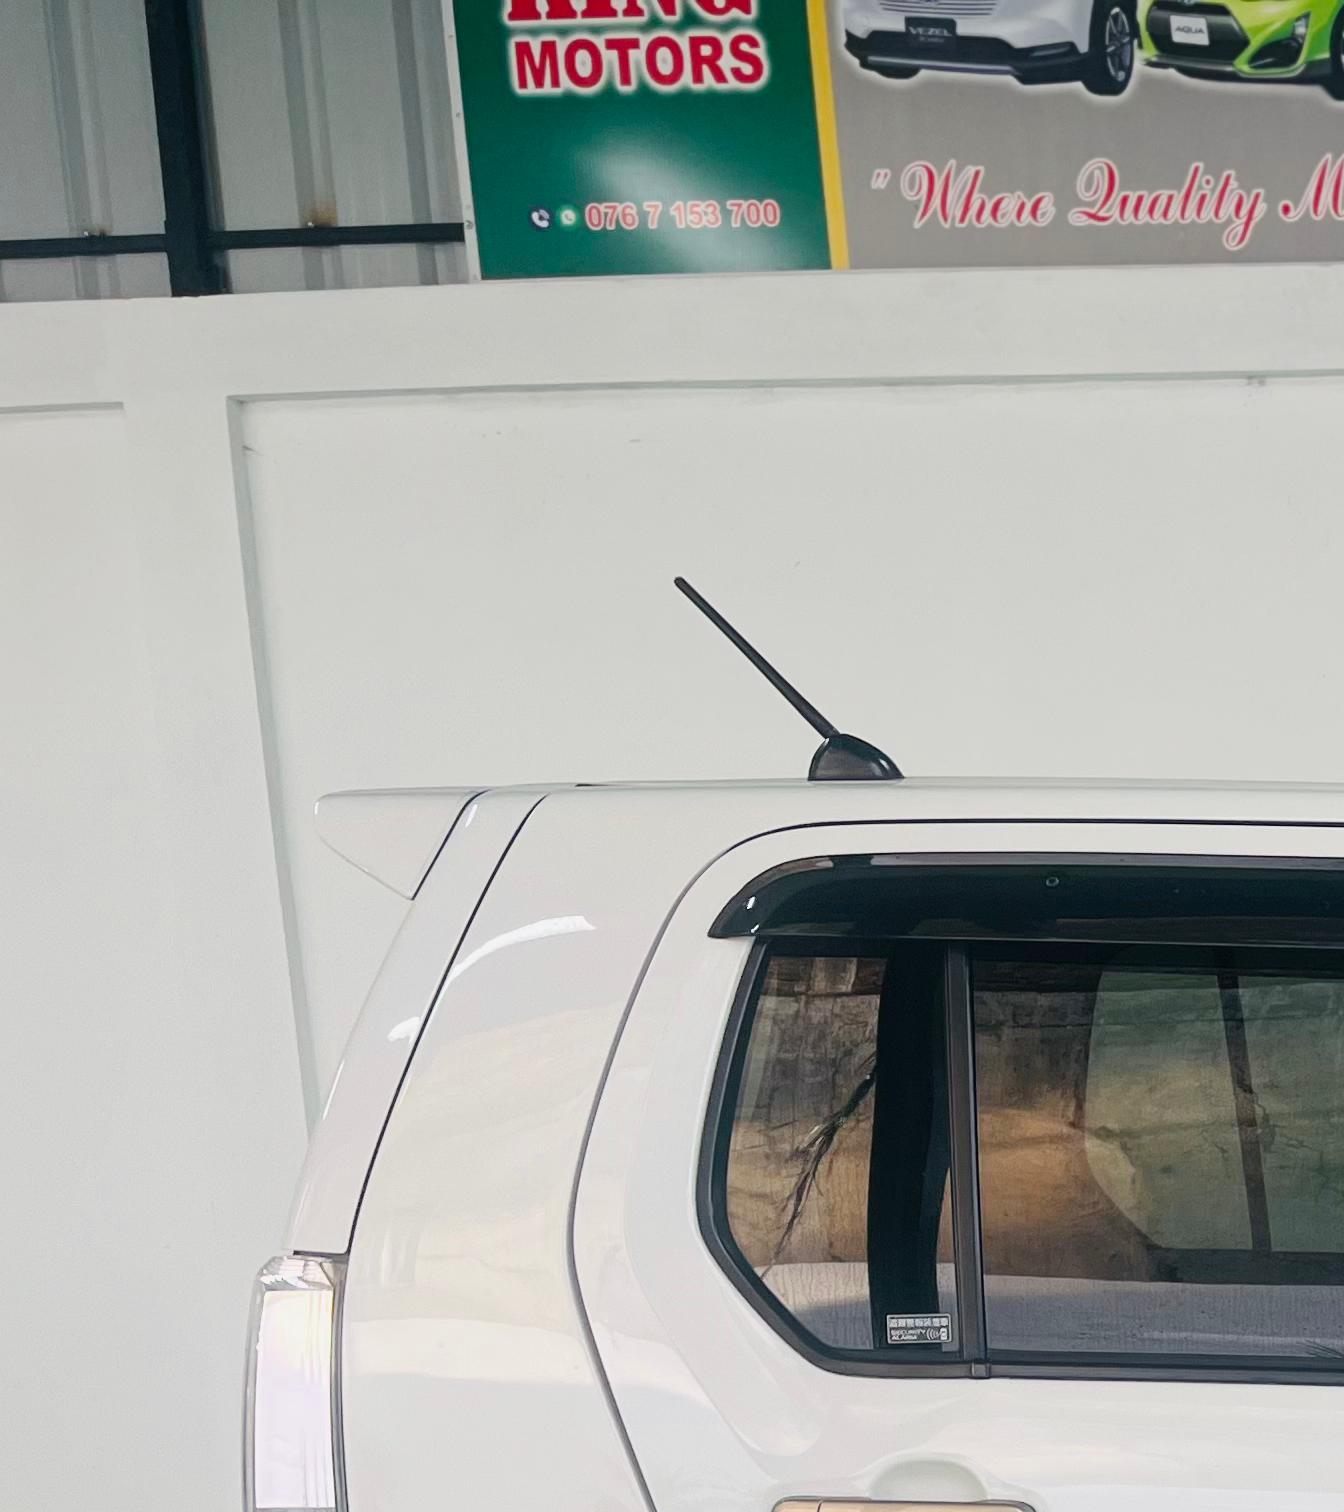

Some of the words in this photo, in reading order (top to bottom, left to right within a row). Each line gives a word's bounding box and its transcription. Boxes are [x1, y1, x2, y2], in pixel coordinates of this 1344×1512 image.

[1175, 25, 1205, 34] AQUA
[512, 32, 766, 91] MOTORS
[585, 203, 639, 230] 076
[643, 202, 662, 229] 7
[670, 200, 722, 229] 153
[727, 199, 780, 228] 700
[1068, 158, 1266, 250] Quality
